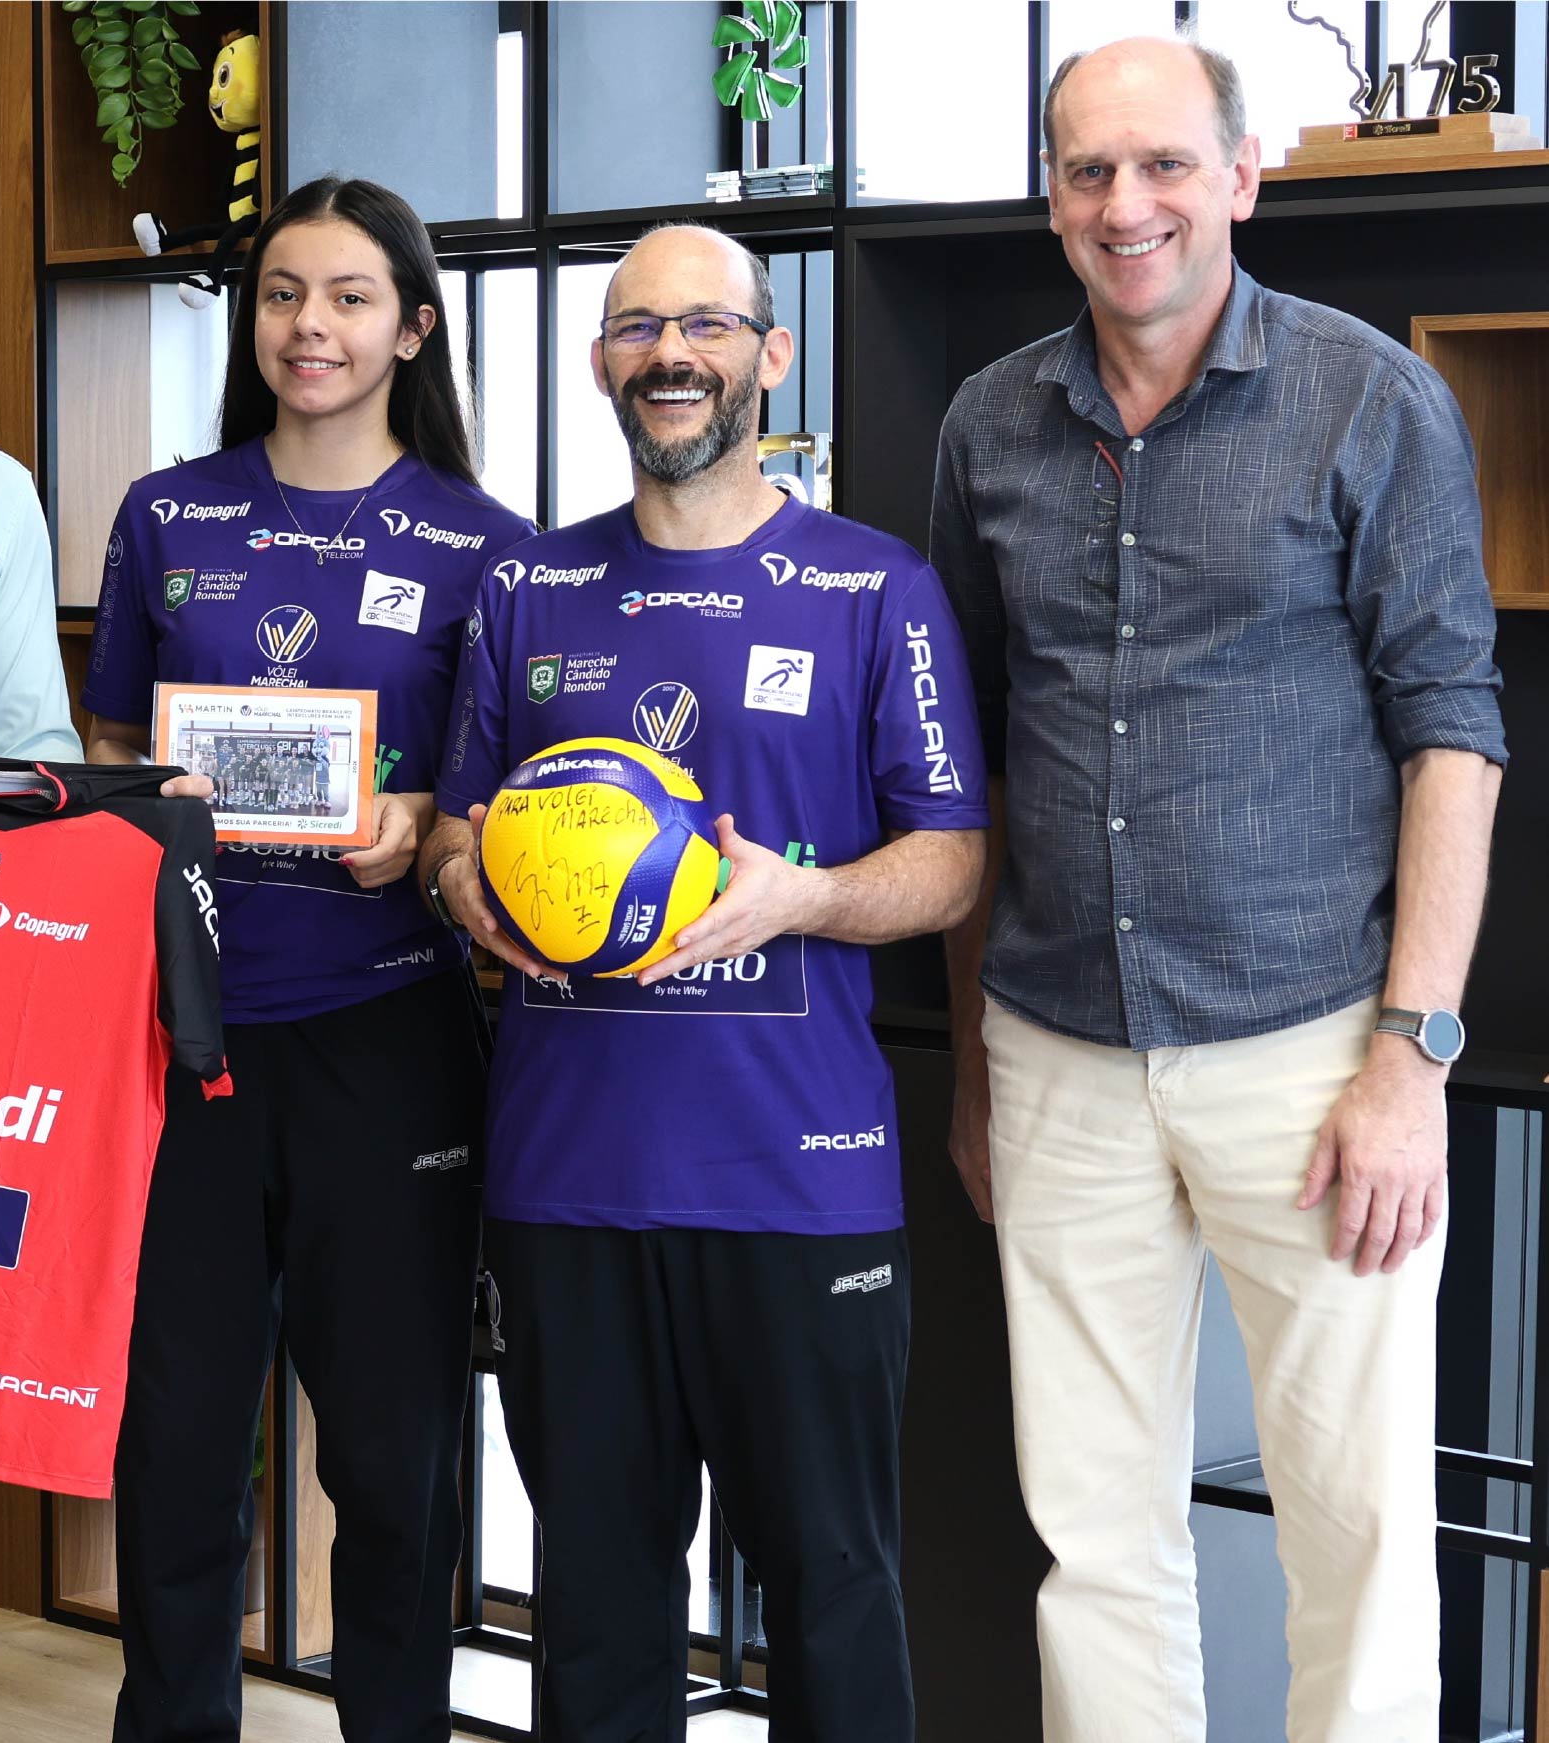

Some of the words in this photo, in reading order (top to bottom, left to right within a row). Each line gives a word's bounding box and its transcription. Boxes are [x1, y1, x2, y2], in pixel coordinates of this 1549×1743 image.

[183, 500, 252, 522] Copagril
[273, 531, 366, 551] OPÇÃO
[413, 521, 486, 550] Copagril
[325, 551, 364, 560] TELECOM
[199, 571, 248, 581] Marechal
[530, 561, 608, 587] Copagril
[801, 566, 887, 592] Copagril
[197, 581, 241, 591] Cândido
[194, 590, 236, 601] Rondon
[645, 591, 744, 609] OPÇÃO
[699, 608, 743, 619] TELECOM
[567, 654, 618, 669] Marechal
[267, 664, 298, 679] VÔLEI
[565, 668, 611, 681] Cândido
[563, 680, 606, 693] Rondon
[195, 705, 233, 713] MARTIN
[310, 820, 342, 829] Sicredi
[14, 912, 89, 941] Copagril
[654, 986, 665, 996] By
[667, 986, 681, 995] the
[683, 986, 708, 997] Whey
